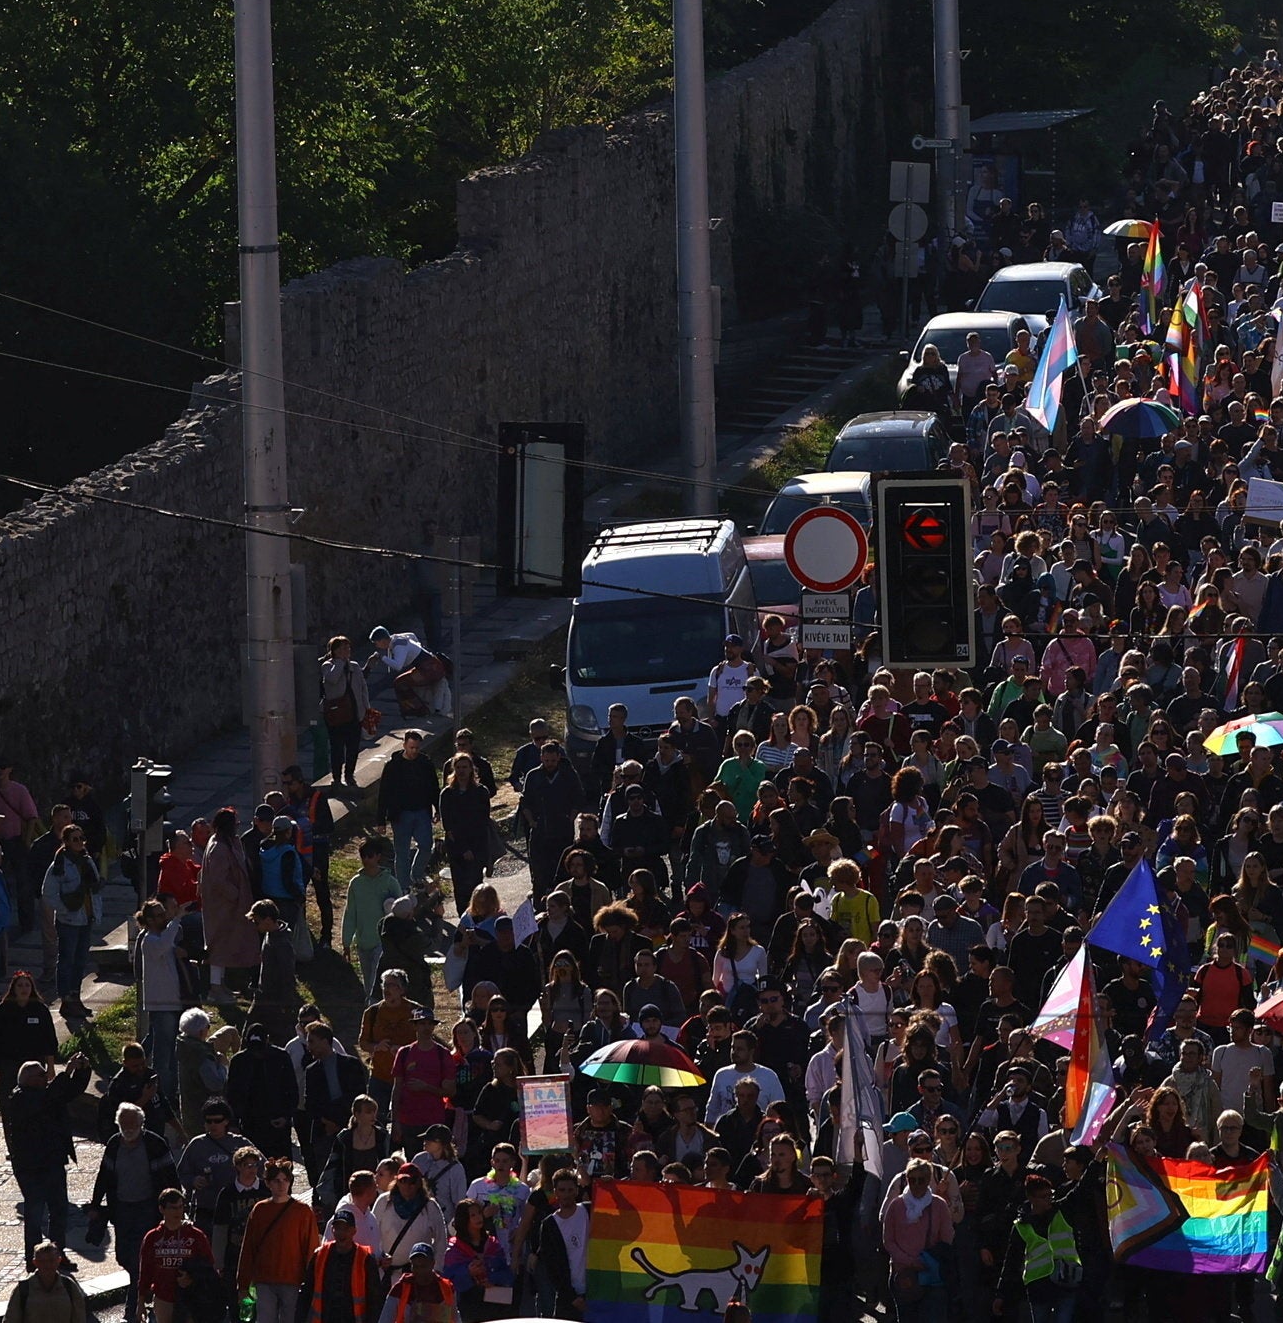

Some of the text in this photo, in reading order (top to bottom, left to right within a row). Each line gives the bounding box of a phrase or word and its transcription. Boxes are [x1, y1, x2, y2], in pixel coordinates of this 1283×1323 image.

[814, 598, 837, 606] KIVÉVE
[804, 631, 849, 643] KIVÉVE TAXI
[957, 646, 968, 655] 24
